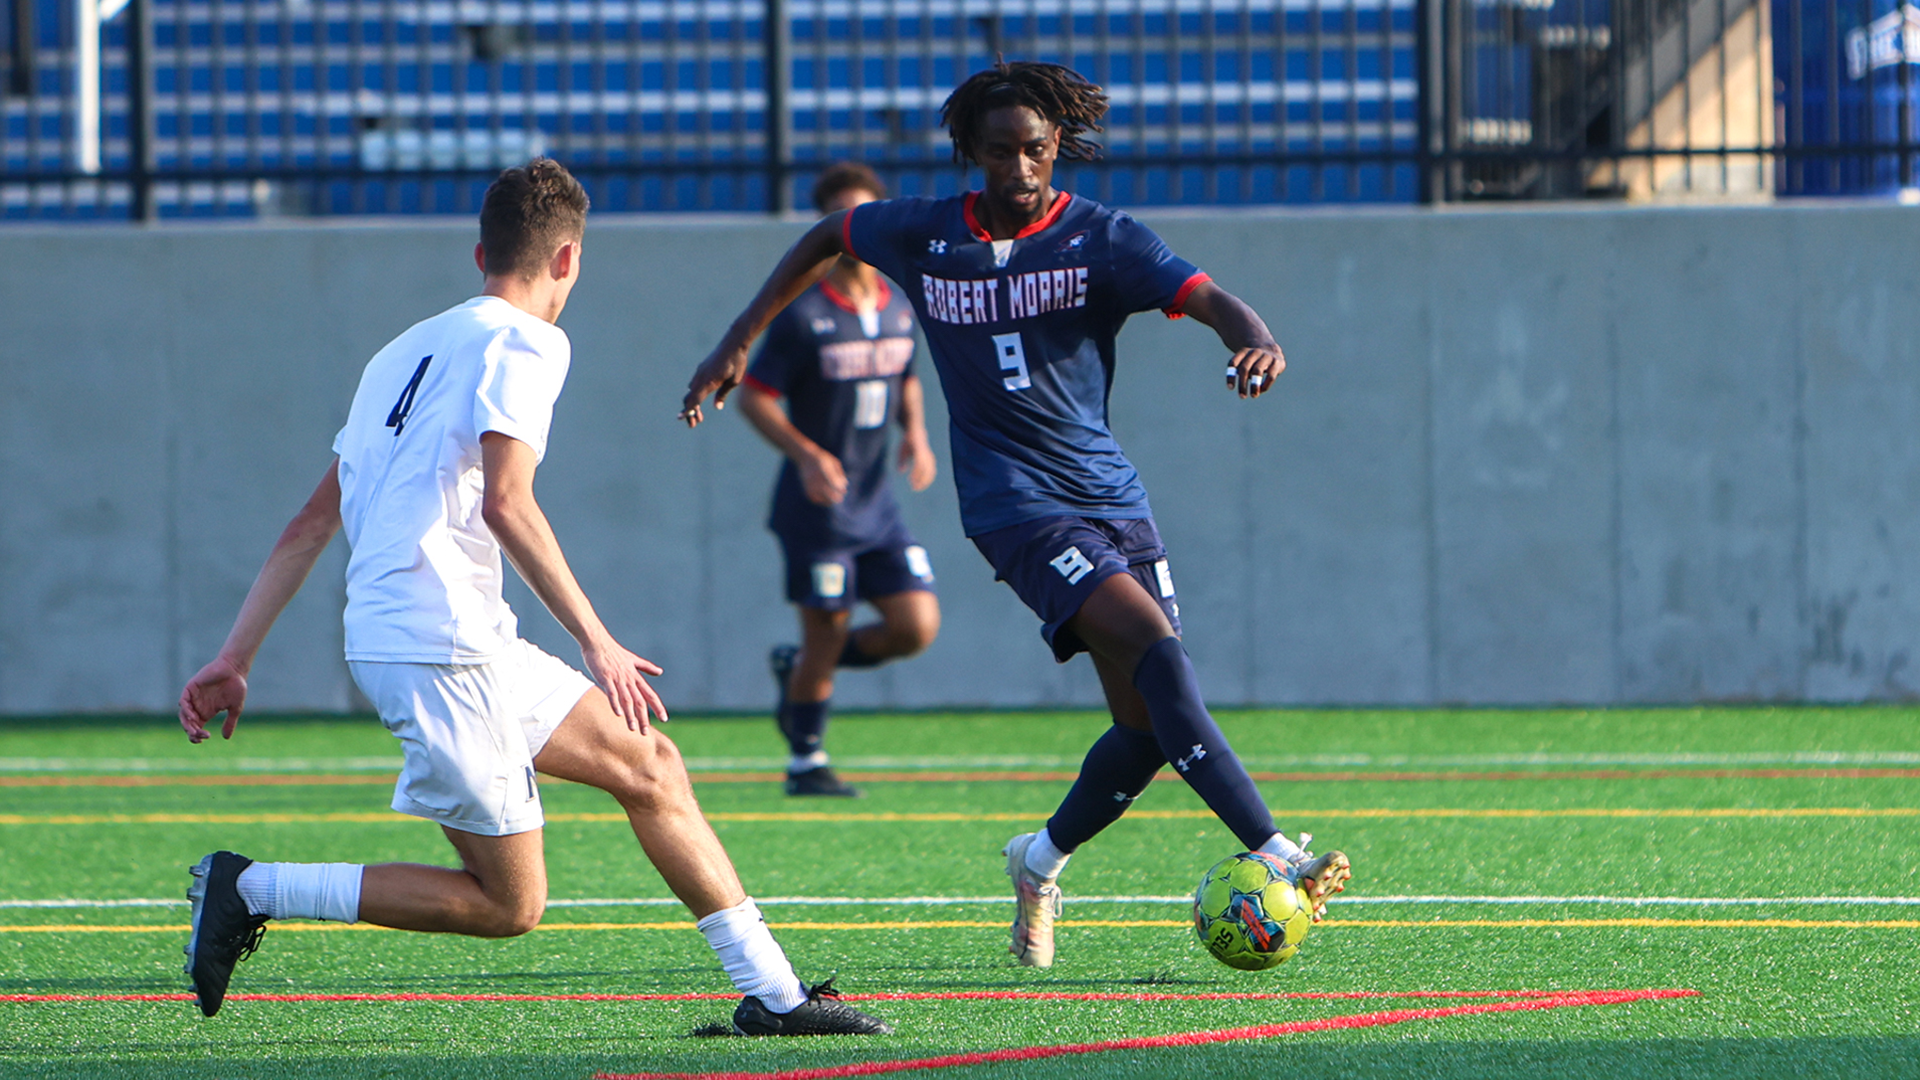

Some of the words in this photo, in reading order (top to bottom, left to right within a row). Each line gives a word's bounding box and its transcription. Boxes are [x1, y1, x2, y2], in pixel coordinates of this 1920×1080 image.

[921, 273, 998, 324] ROBERT
[1007, 267, 1088, 319] MORRIS
[992, 332, 1031, 391] 9
[385, 354, 434, 437] 4
[1050, 546, 1095, 585] 9
